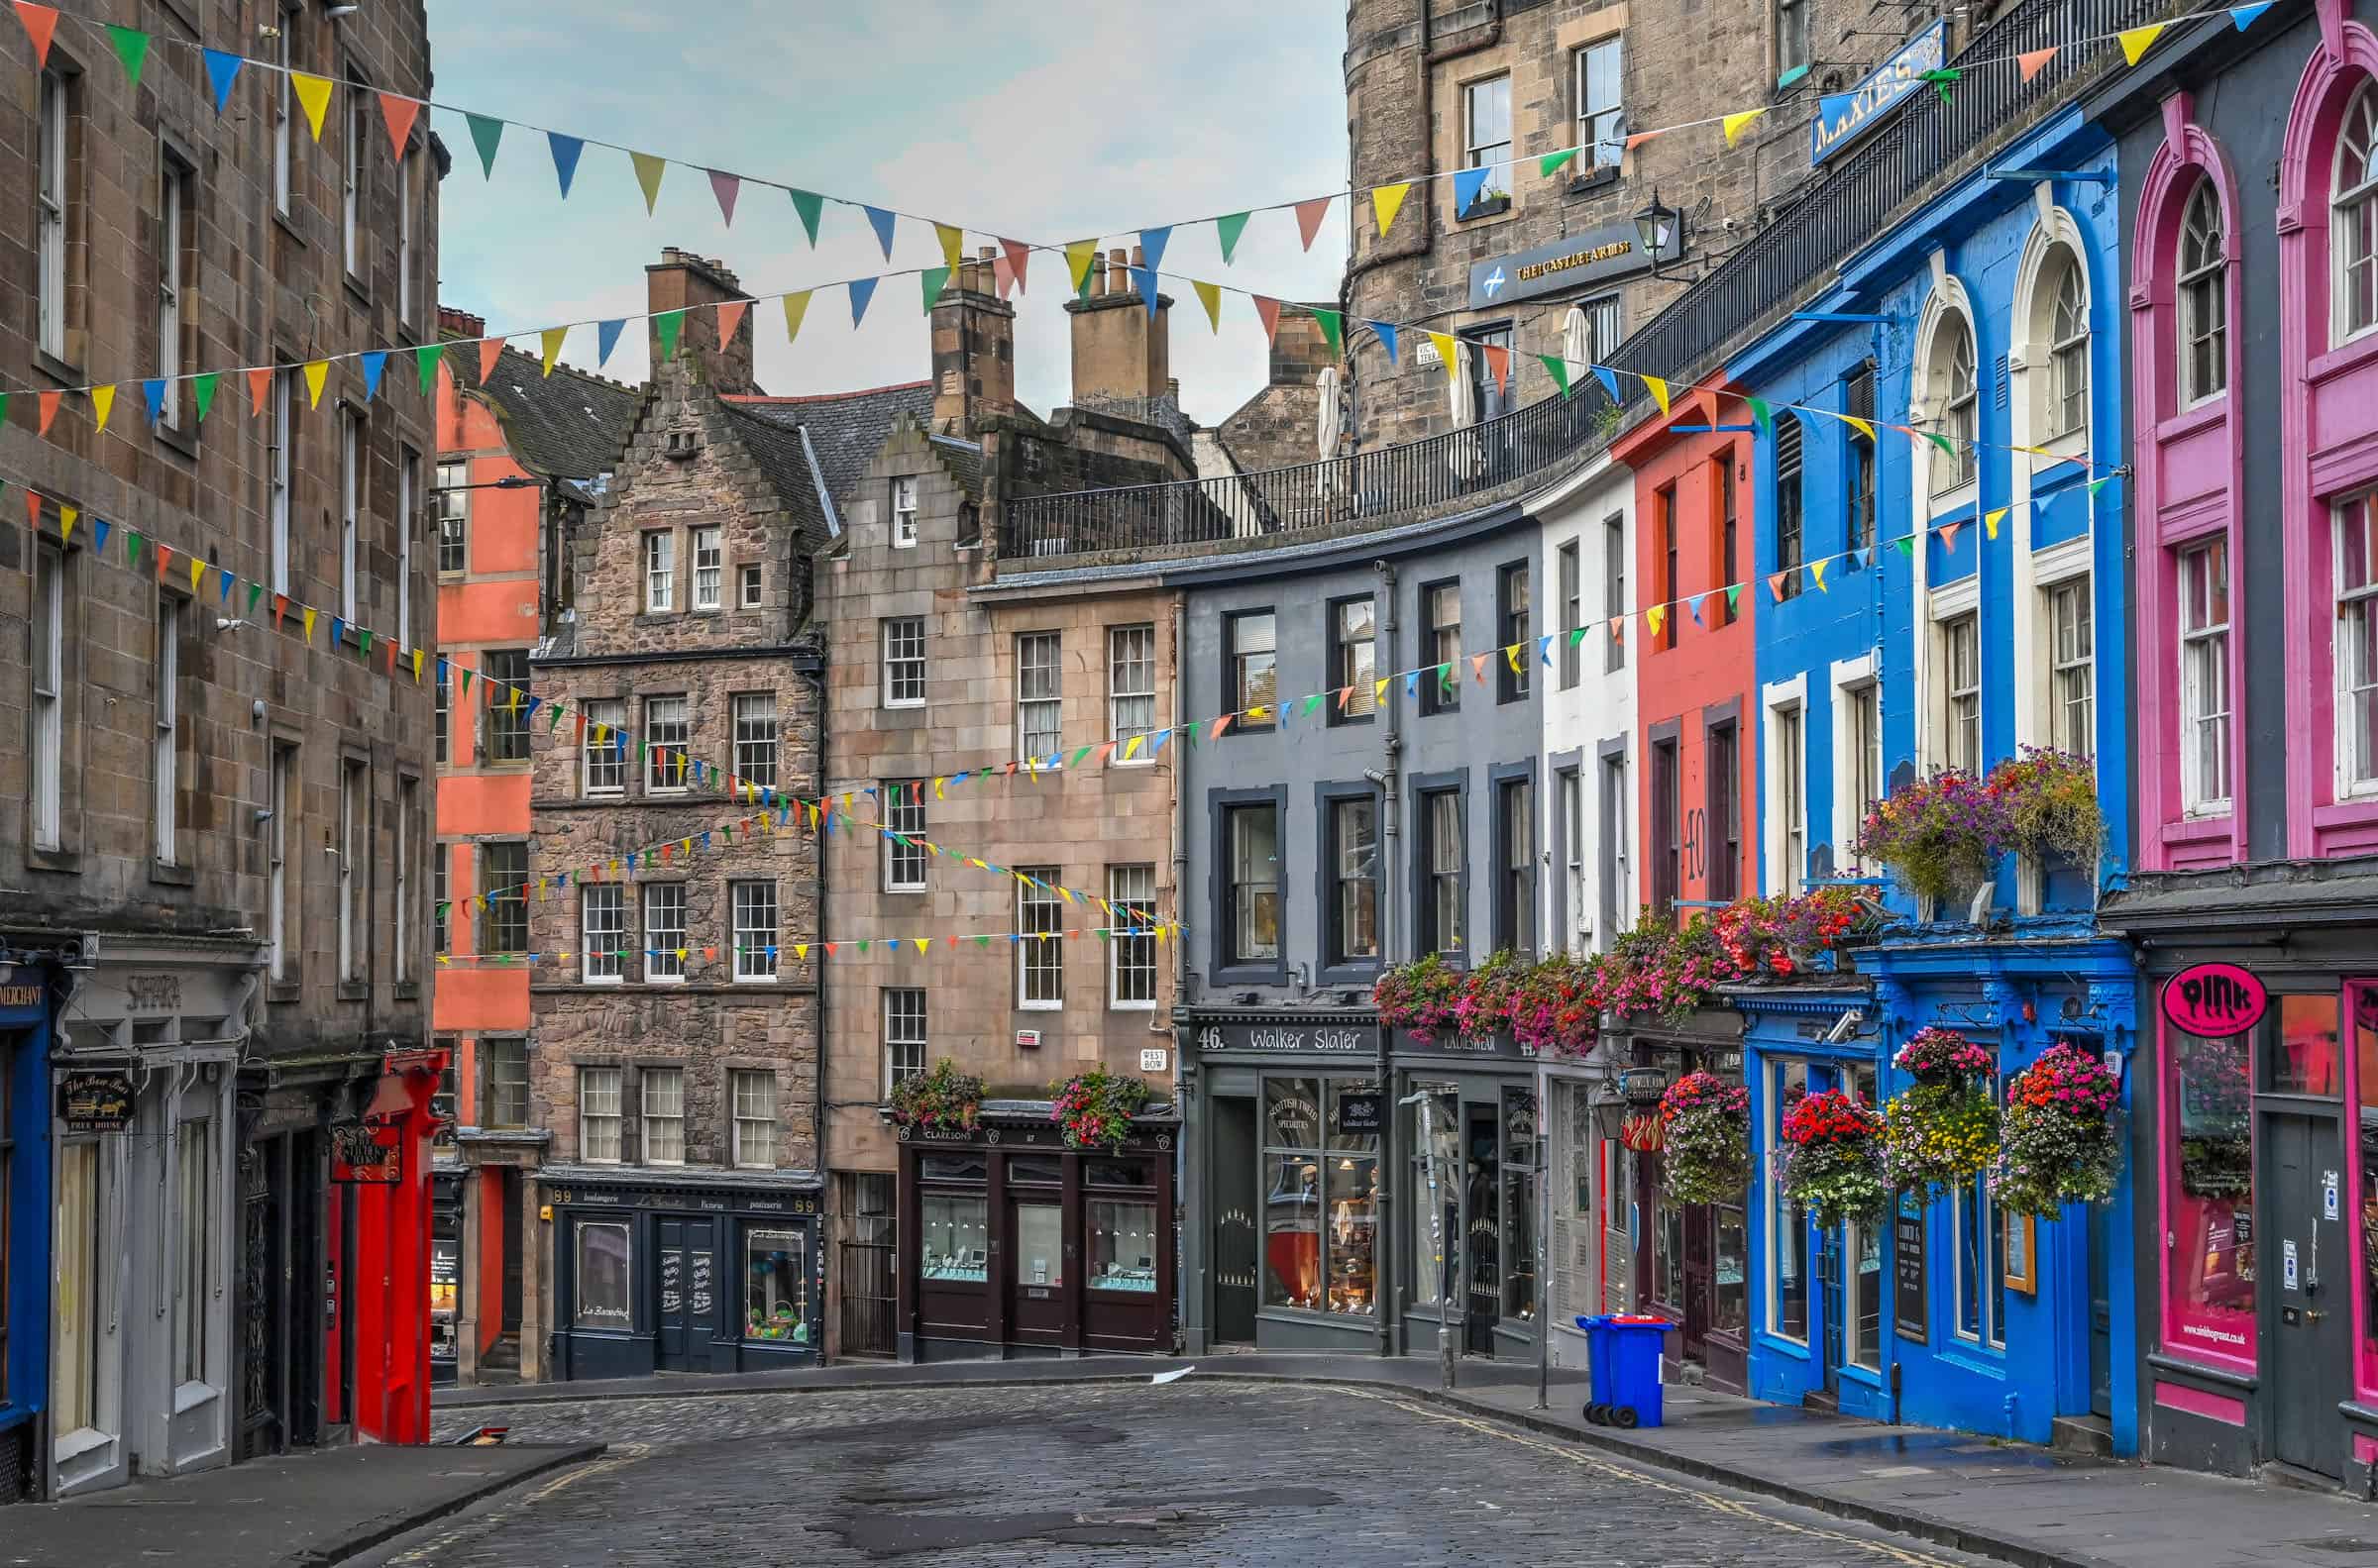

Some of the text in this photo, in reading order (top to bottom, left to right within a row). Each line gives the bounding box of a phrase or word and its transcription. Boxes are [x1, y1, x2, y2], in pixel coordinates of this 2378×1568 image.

[1515, 263, 1539, 280] THE
[1543, 251, 1587, 274] CASTLE
[1681, 807, 1705, 880] 40
[1250, 1027, 1360, 1049] Walker Slater
[1142, 1050, 1164, 1060] WEST
[1144, 1060, 1162, 1069] BOW
[554, 1190, 572, 1202] 89
[795, 1200, 814, 1213] 89
